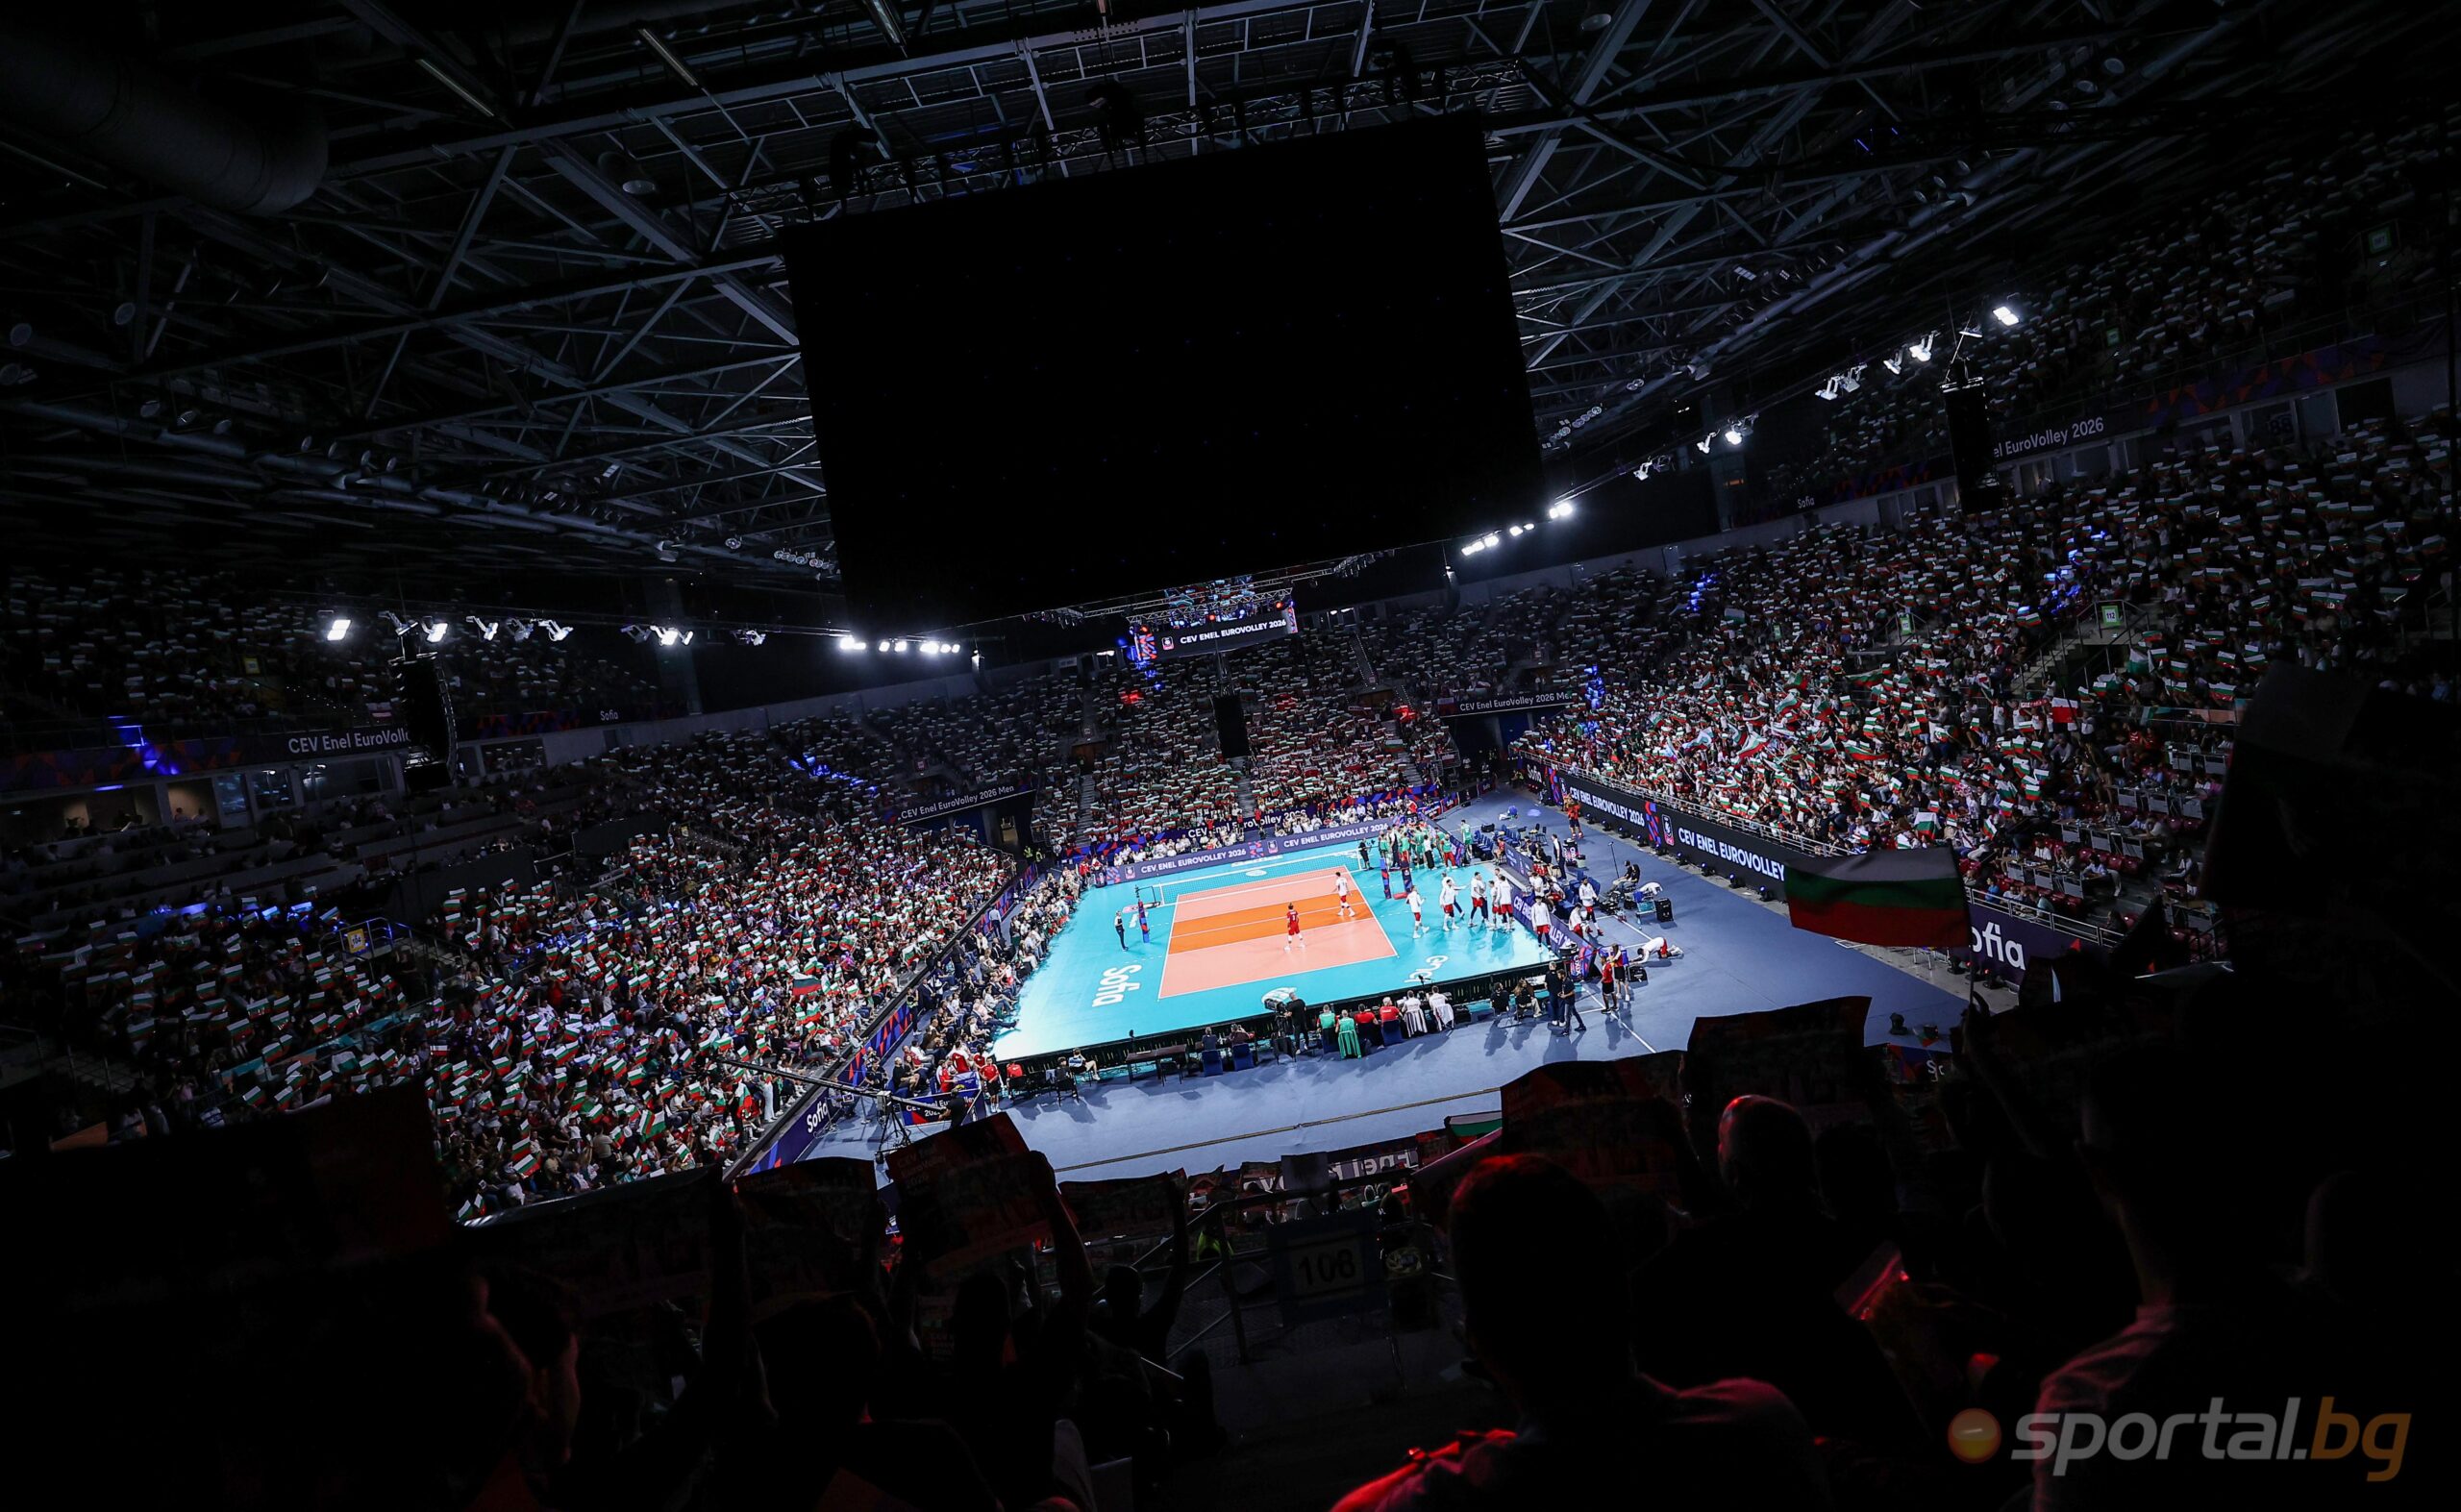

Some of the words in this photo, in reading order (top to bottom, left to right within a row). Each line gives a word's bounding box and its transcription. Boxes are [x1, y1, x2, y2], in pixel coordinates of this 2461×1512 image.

[2005, 429, 2068, 456] EuroVolley
[2072, 416, 2104, 438] 2026
[1797, 495, 1815, 509] Sofia
[1180, 634, 1198, 644] CEV
[1200, 632, 1220, 641] ENEL
[1221, 622, 1269, 637] EUROVOLLEY
[1269, 619, 1287, 629] 2026
[1459, 702, 1475, 712] CEV
[1477, 700, 1492, 710] Enel
[1494, 695, 1534, 708] EuroVolley
[1535, 693, 1554, 704] 2026
[1556, 692, 1573, 701] Me
[600, 709, 619, 722] Sofia
[288, 736, 319, 755] CEV
[322, 732, 352, 752] Enel
[901, 808, 918, 820] CEV
[919, 803, 937, 815] Enel
[938, 794, 979, 810] EuroVolley
[980, 788, 998, 800] 2026
[998, 784, 1015, 796] Men
[1569, 786, 1581, 802] CEV
[1580, 790, 1593, 807] ENEL
[1592, 794, 1629, 820] EUROVOLLEY
[1628, 809, 1646, 827] 2026
[1187, 827, 1207, 838] CEV
[1283, 838, 1300, 848] CEV
[1301, 835, 1320, 846] ENEL
[1321, 827, 1370, 842] EUROVOLLEY
[1370, 823, 1389, 832] 2026
[1141, 864, 1156, 874] CEV
[1157, 861, 1178, 872] ENEL
[1178, 852, 1227, 867] EUROVOLLEY
[1229, 849, 1247, 858] 2026
[1678, 828, 1695, 847] CEV
[1697, 833, 1719, 855] ENEL
[1719, 841, 1785, 881] EUROVOLLEY
[1092, 964, 1142, 1007] Sofia
[807, 1100, 828, 1133] Sofia
[1299, 1249, 1356, 1286] 108
